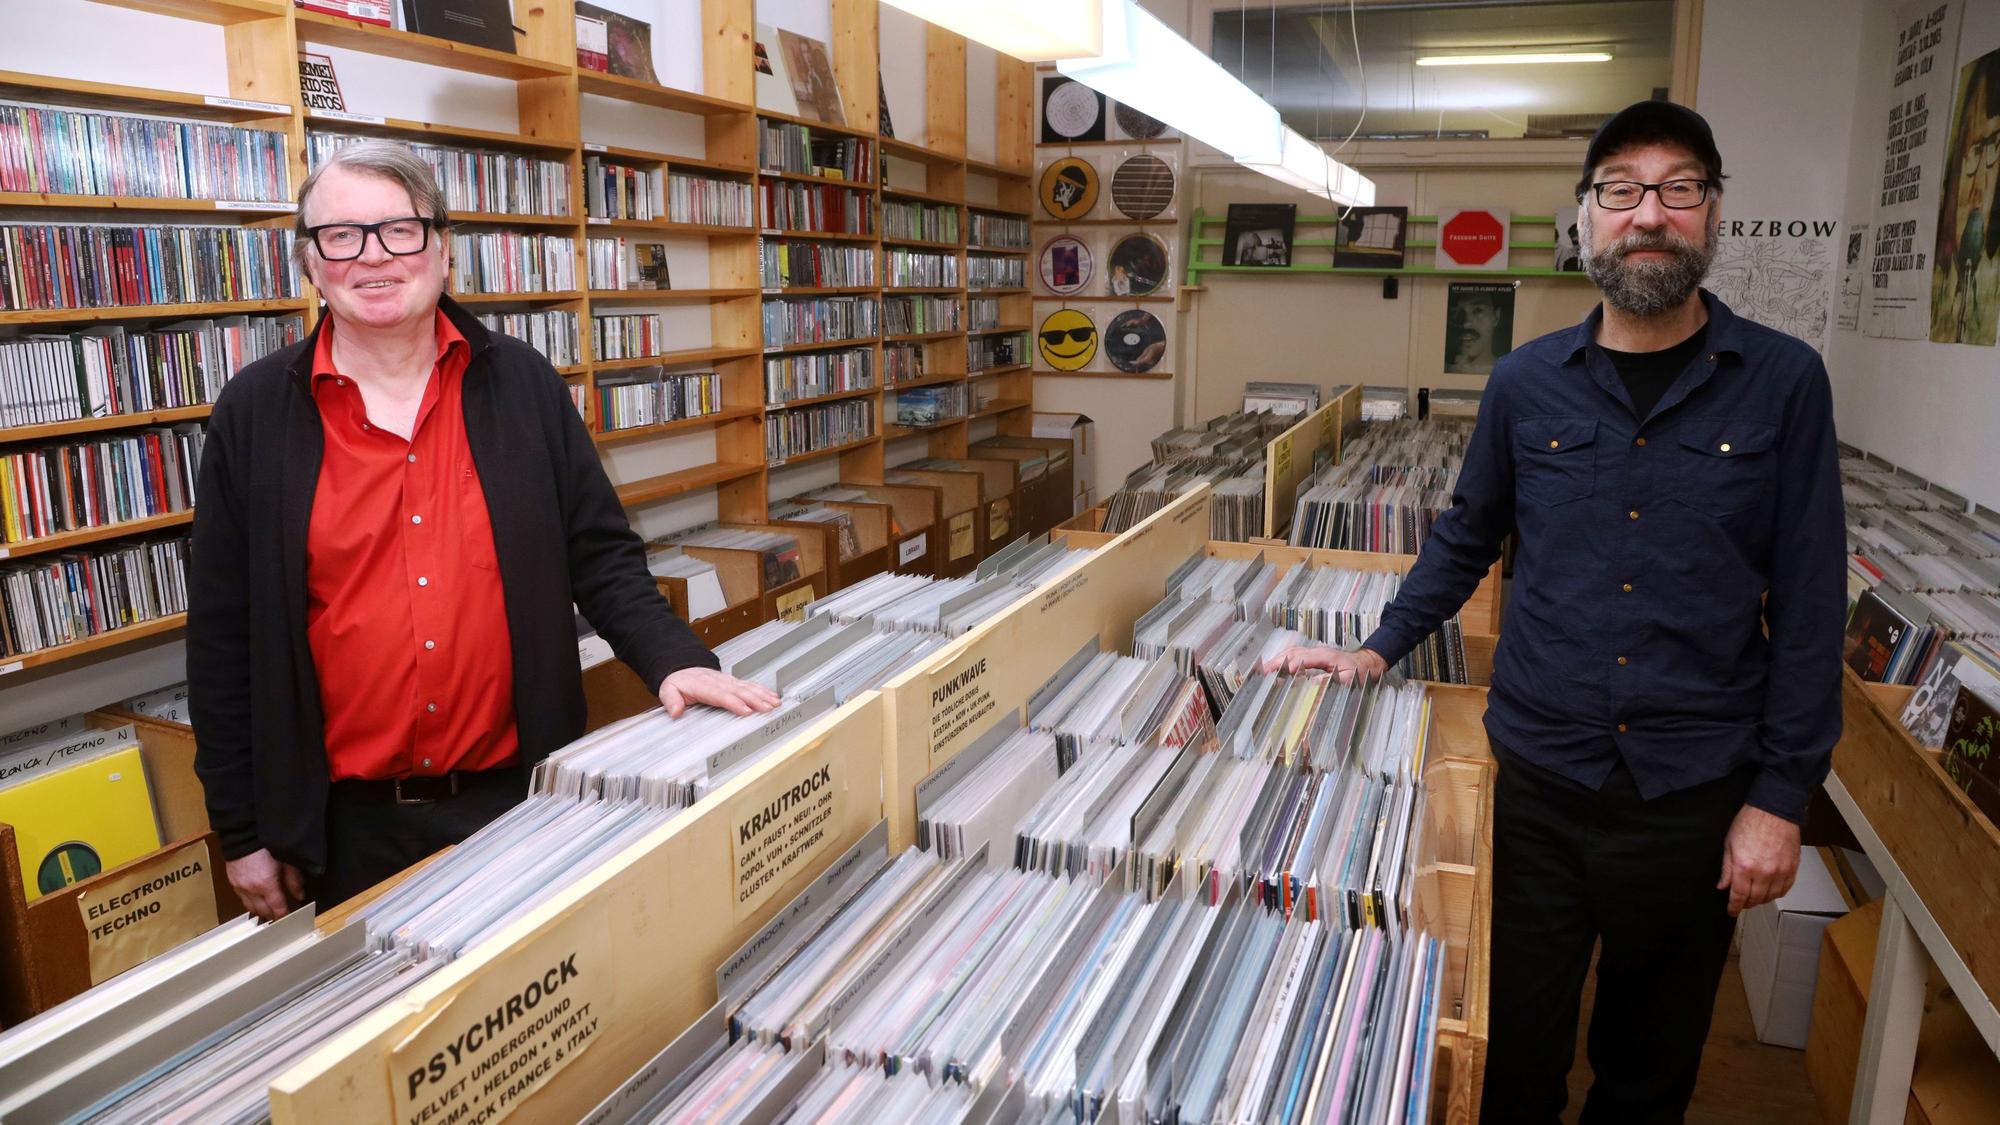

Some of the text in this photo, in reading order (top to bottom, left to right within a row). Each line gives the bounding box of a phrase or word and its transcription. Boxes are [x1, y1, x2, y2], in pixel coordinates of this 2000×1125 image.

[301, 92, 343, 111] RATOS
[1718, 220, 1837, 238] ERZBOW
[932, 658, 987, 707] PUNK/WAVE
[965, 686, 979, 700] DORIS
[118, 728, 128, 741] N
[739, 763, 831, 845] KRAUTROCK
[740, 791, 833, 865] CAN FAUST NEU! OHR
[739, 829, 824, 903] CLUSTER KRAFTWERK
[740, 806, 833, 886] POPOL VUH SCHNITZLER
[88, 861, 203, 921] ELECTRONICA
[91, 900, 162, 941] TECHNO
[408, 952, 580, 1101] PSYCHROCK
[409, 997, 571, 1125] VELVET UNDERGROUND
[483, 1044, 538, 1098] HELDON
[550, 1002, 593, 1046] WYATT
[500, 1058, 553, 1106] FRANCE
[567, 1017, 600, 1053] ITALY
